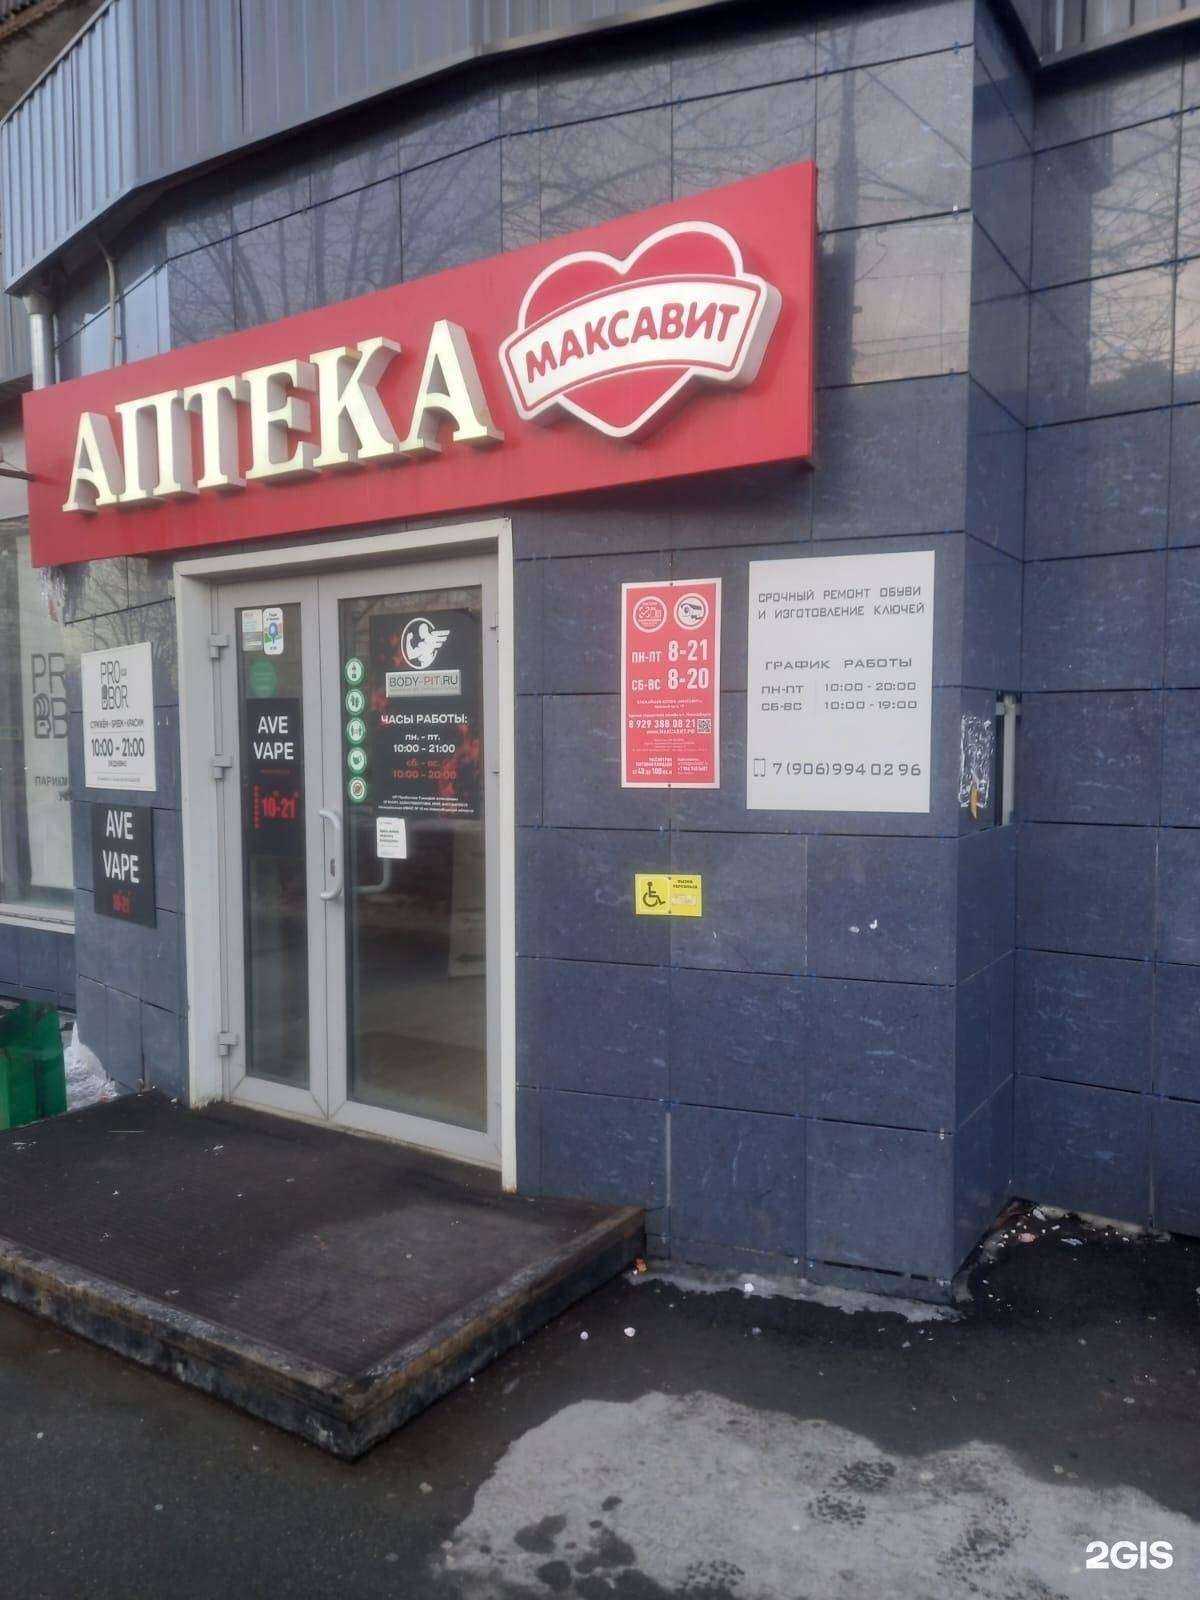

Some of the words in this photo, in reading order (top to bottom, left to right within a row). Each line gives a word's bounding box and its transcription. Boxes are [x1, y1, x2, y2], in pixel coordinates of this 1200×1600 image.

[525, 301, 741, 384] МАКСАВИТ
[62, 319, 505, 515] АПТЕКА
[758, 588, 815, 603] СРОЧНЫЙ
[823, 588, 871, 600] РЕМОНТ
[880, 586, 921, 598] ОБУВИ
[758, 610, 766, 620] И
[775, 606, 864, 619] ИЗГОТОВЛЕНИЕ
[874, 601, 925, 615] КЛЮЧЕЙ
[632, 651, 662, 663] ПН-ПТ
[668, 639, 708, 661] 8-21
[765, 659, 831, 670] ГРАФИК
[844, 658, 912, 669] РАБОТЫ
[632, 679, 661, 691] СБ-ВС
[668, 667, 709, 689] 8-20
[761, 685, 804, 694] ПН-ПТ
[825, 682, 863, 692] 10:00
[875, 682, 916, 691] 20:00
[761, 702, 802, 711] СБ-ВС
[825, 701, 865, 710] 10:00
[878, 701, 917, 709] 19:00
[258, 716, 288, 734] AVE
[381, 715, 414, 724] ЧАСЫ
[417, 714, 468, 723] РАБОТЫ:
[628, 720, 633, 728] 8
[636, 720, 652, 728] 929
[685, 719, 696, 727] 21
[92, 738, 113, 757] 10:00
[122, 737, 145, 757] 21:00
[254, 742, 294, 760] VAPE
[429, 744, 455, 752] 21:00
[772, 763, 782, 775] 7
[106, 810, 134, 840] AVE
[103, 850, 139, 883] VAPE
